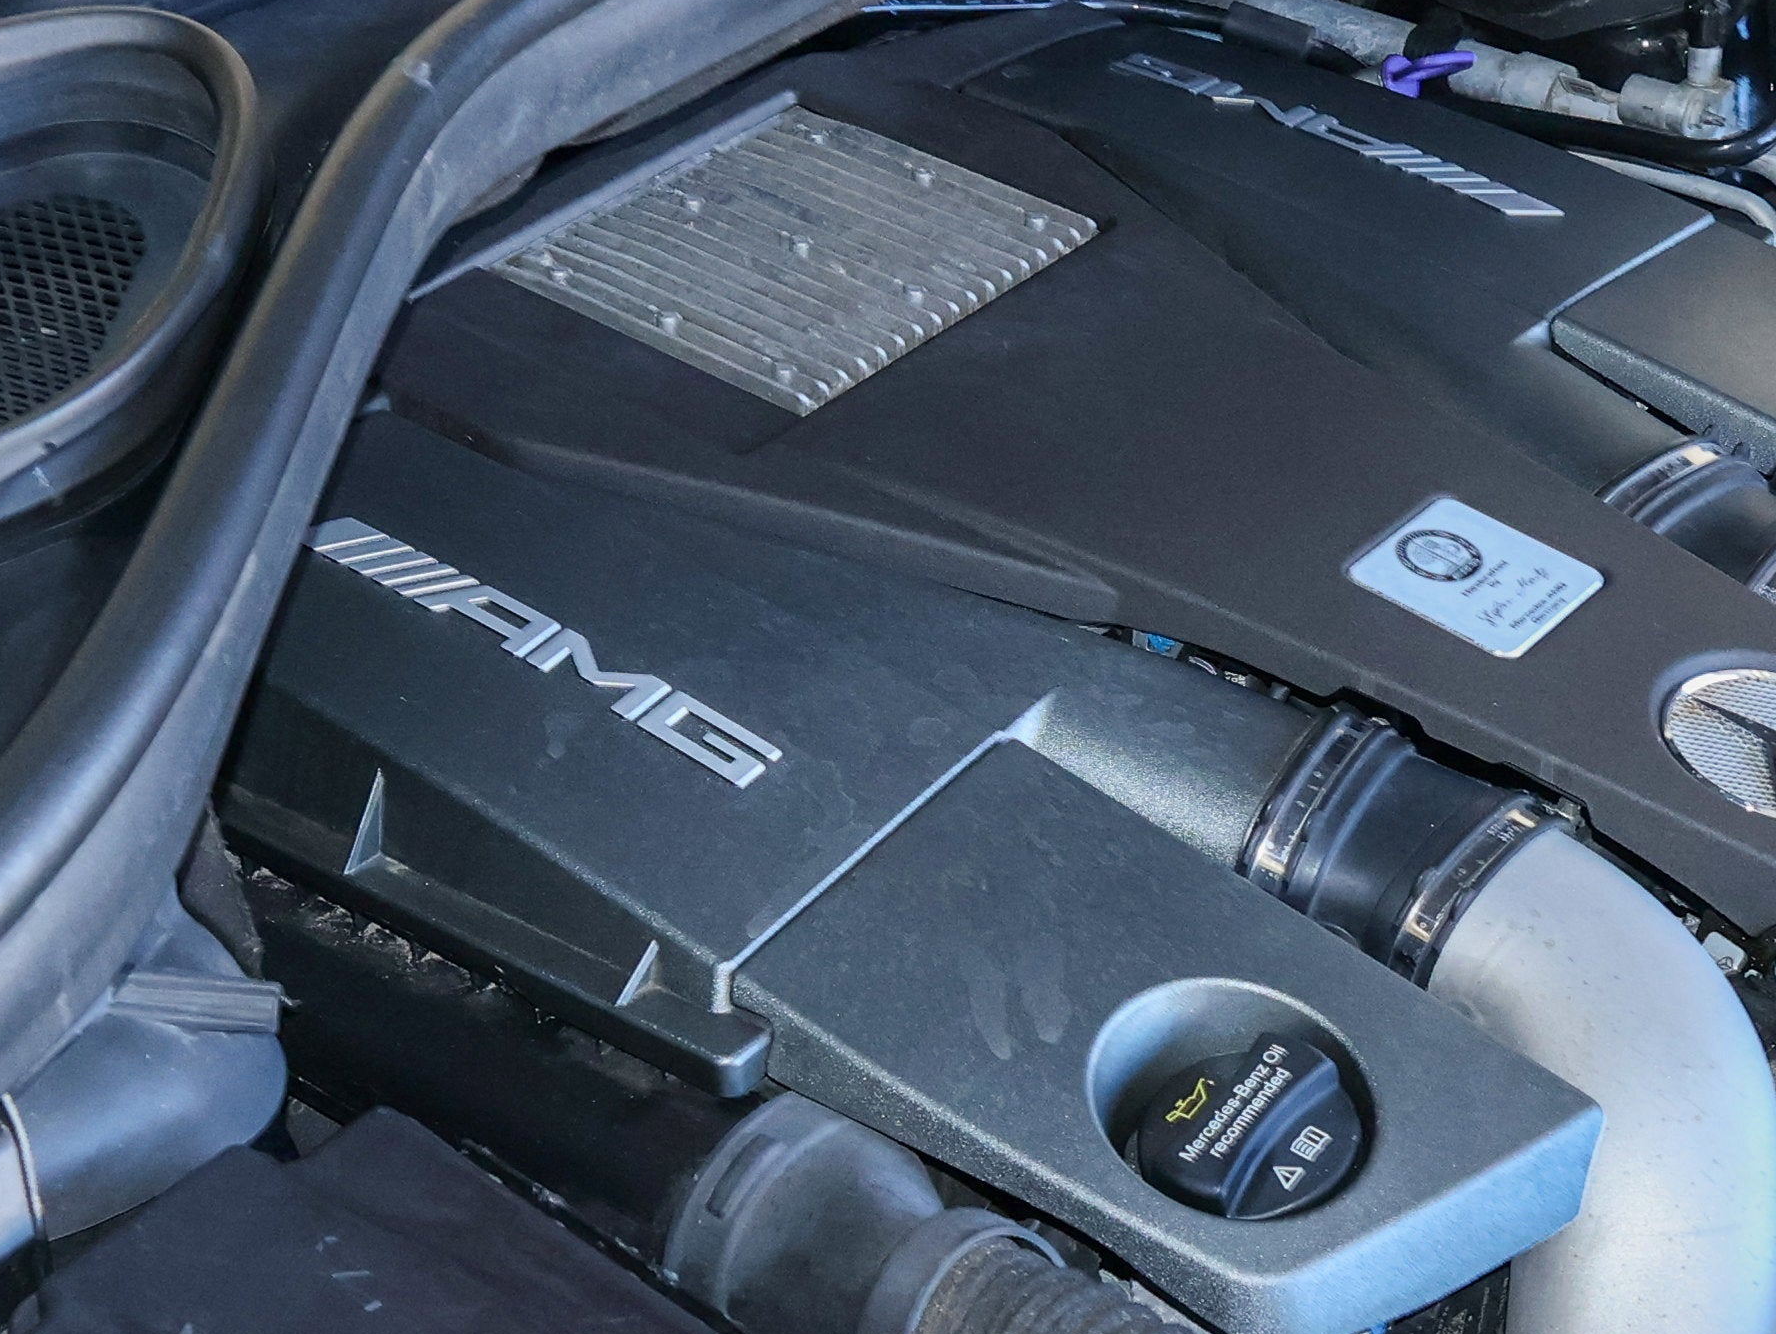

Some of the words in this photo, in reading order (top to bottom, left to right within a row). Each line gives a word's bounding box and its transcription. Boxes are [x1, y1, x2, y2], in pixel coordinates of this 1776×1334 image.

[414, 584, 784, 789] AMG
[1178, 1063, 1272, 1163] Mercedes-Benz
[1262, 1043, 1290, 1066] Oil
[1209, 1066, 1293, 1160] recommended
